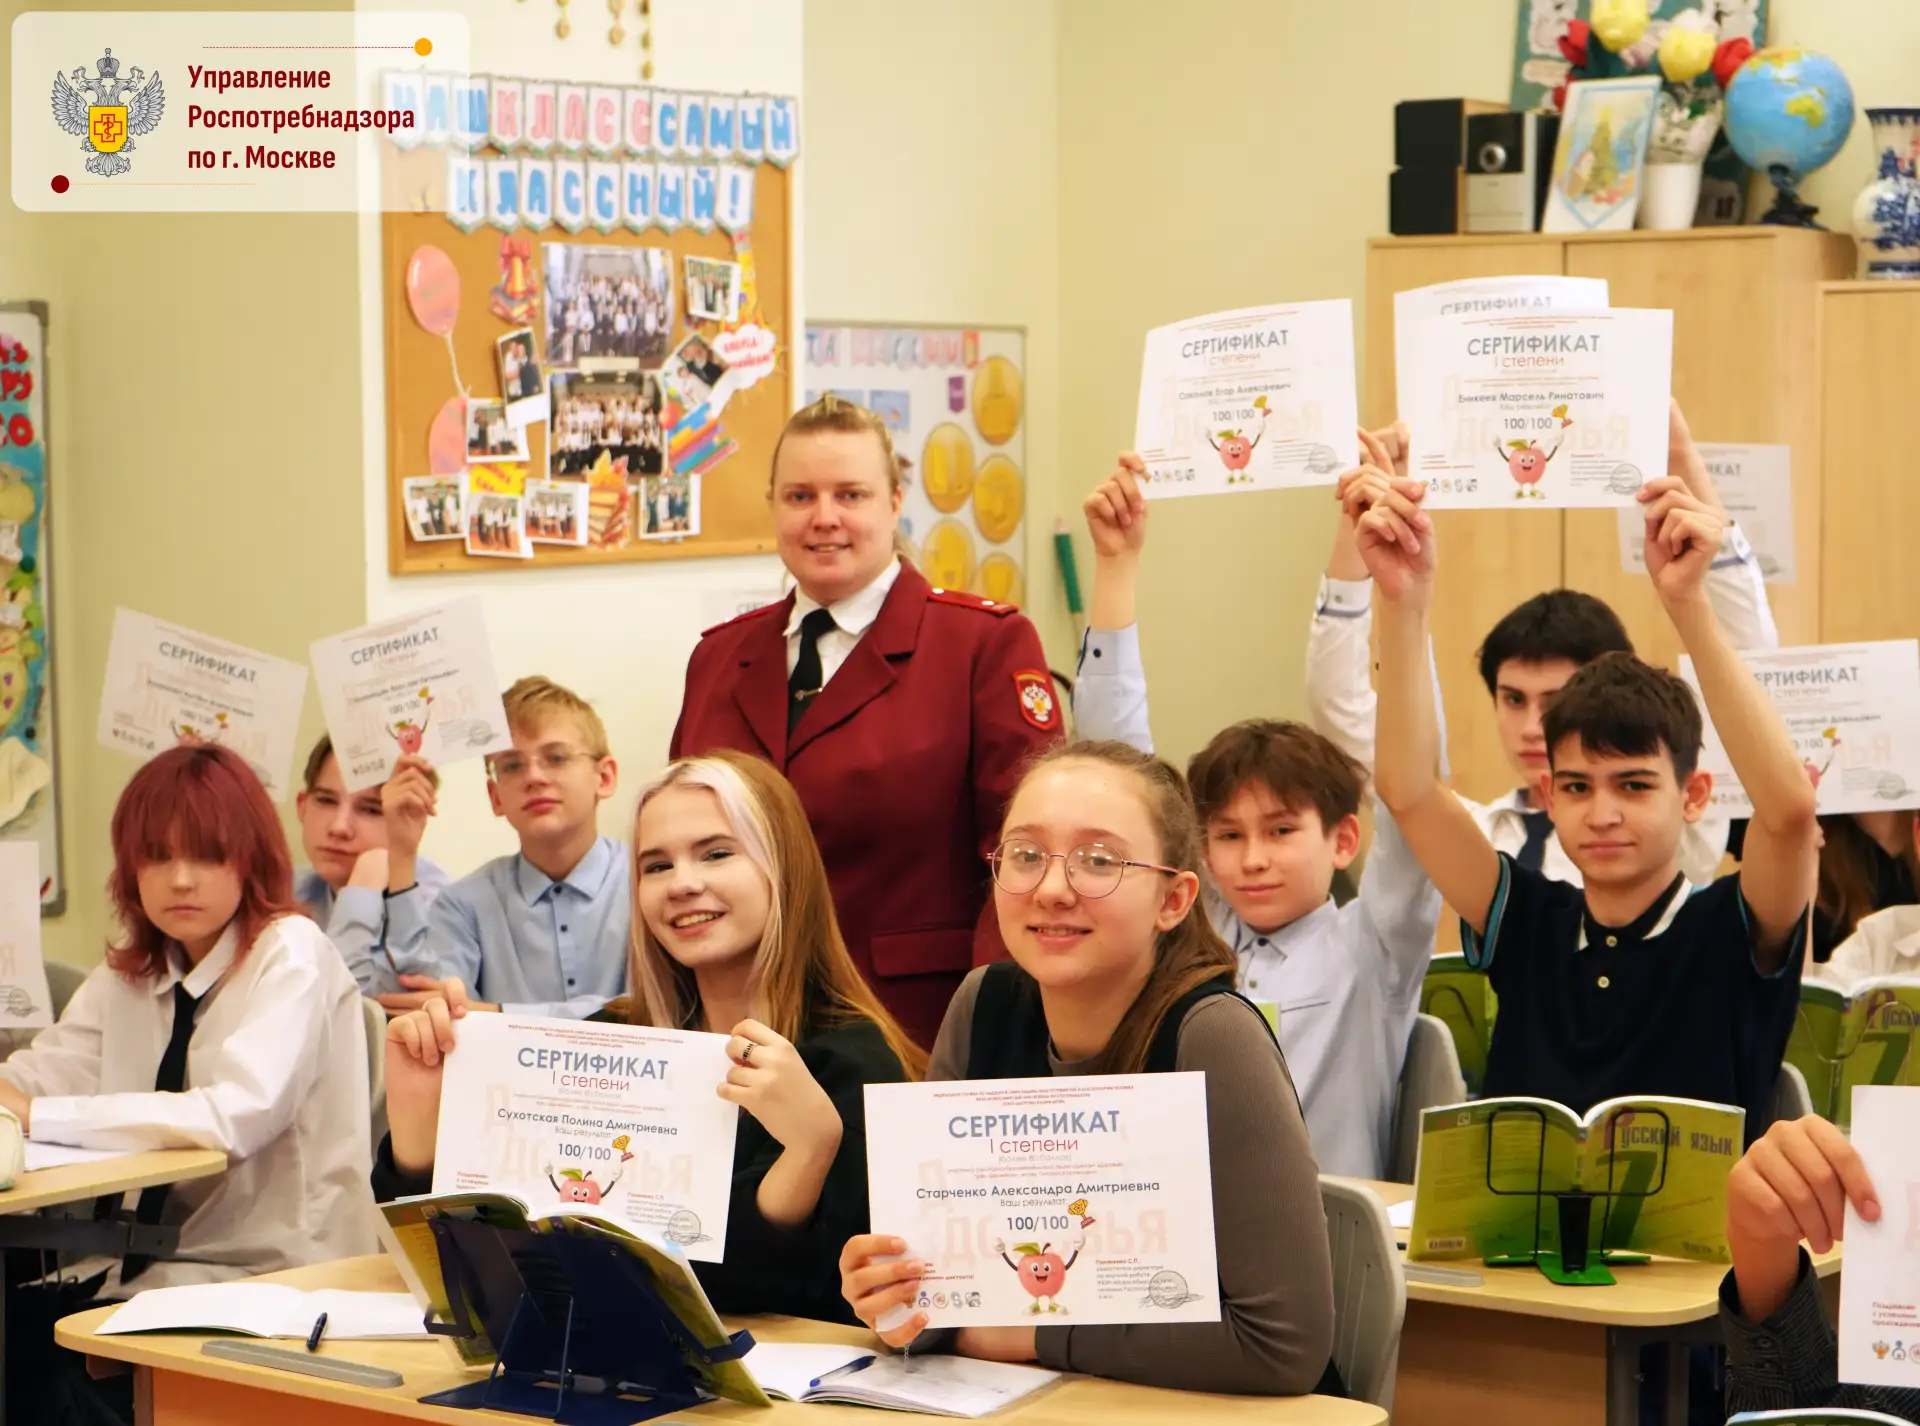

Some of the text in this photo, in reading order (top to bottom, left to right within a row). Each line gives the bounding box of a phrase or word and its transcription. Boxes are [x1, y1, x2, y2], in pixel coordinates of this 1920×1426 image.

[391, 84, 792, 151] НАШ КЛАСС САМЫЙ
[455, 166, 741, 222] КЛАССНЫЙ!
[1181, 329, 1289, 359] СЕРТИФИКАТ
[1467, 334, 1601, 356] СЕРТИФИКАТ
[1208, 352, 1261, 367] степени
[1501, 355, 1565, 368] степени
[1458, 390, 1605, 403] Еникеев Марсель Ринатович
[1212, 408, 1256, 422] 100/100
[1503, 417, 1553, 430] 100/100
[351, 626, 440, 666] СЕРТИФИКАТ
[158, 640, 258, 684] СЕРТИФИКАТ
[517, 1047, 668, 1080] СЕРТИФИКАТ
[551, 1071, 630, 1093] I степени
[497, 1108, 678, 1136] Сухотская Полина Дмитриевна
[948, 1109, 1120, 1139] СЕРТИФИКАТ
[557, 1143, 612, 1161] 100/100
[990, 1138, 1079, 1154] I степени
[1690, 1131, 1733, 1156] язык
[916, 1180, 1160, 1200] Старченко Александра Дмитриевна
[1596, 1150, 1658, 1249] 7
[1000, 1198, 1020, 1207] Ваш
[1006, 1216, 1069, 1231] 100/100
